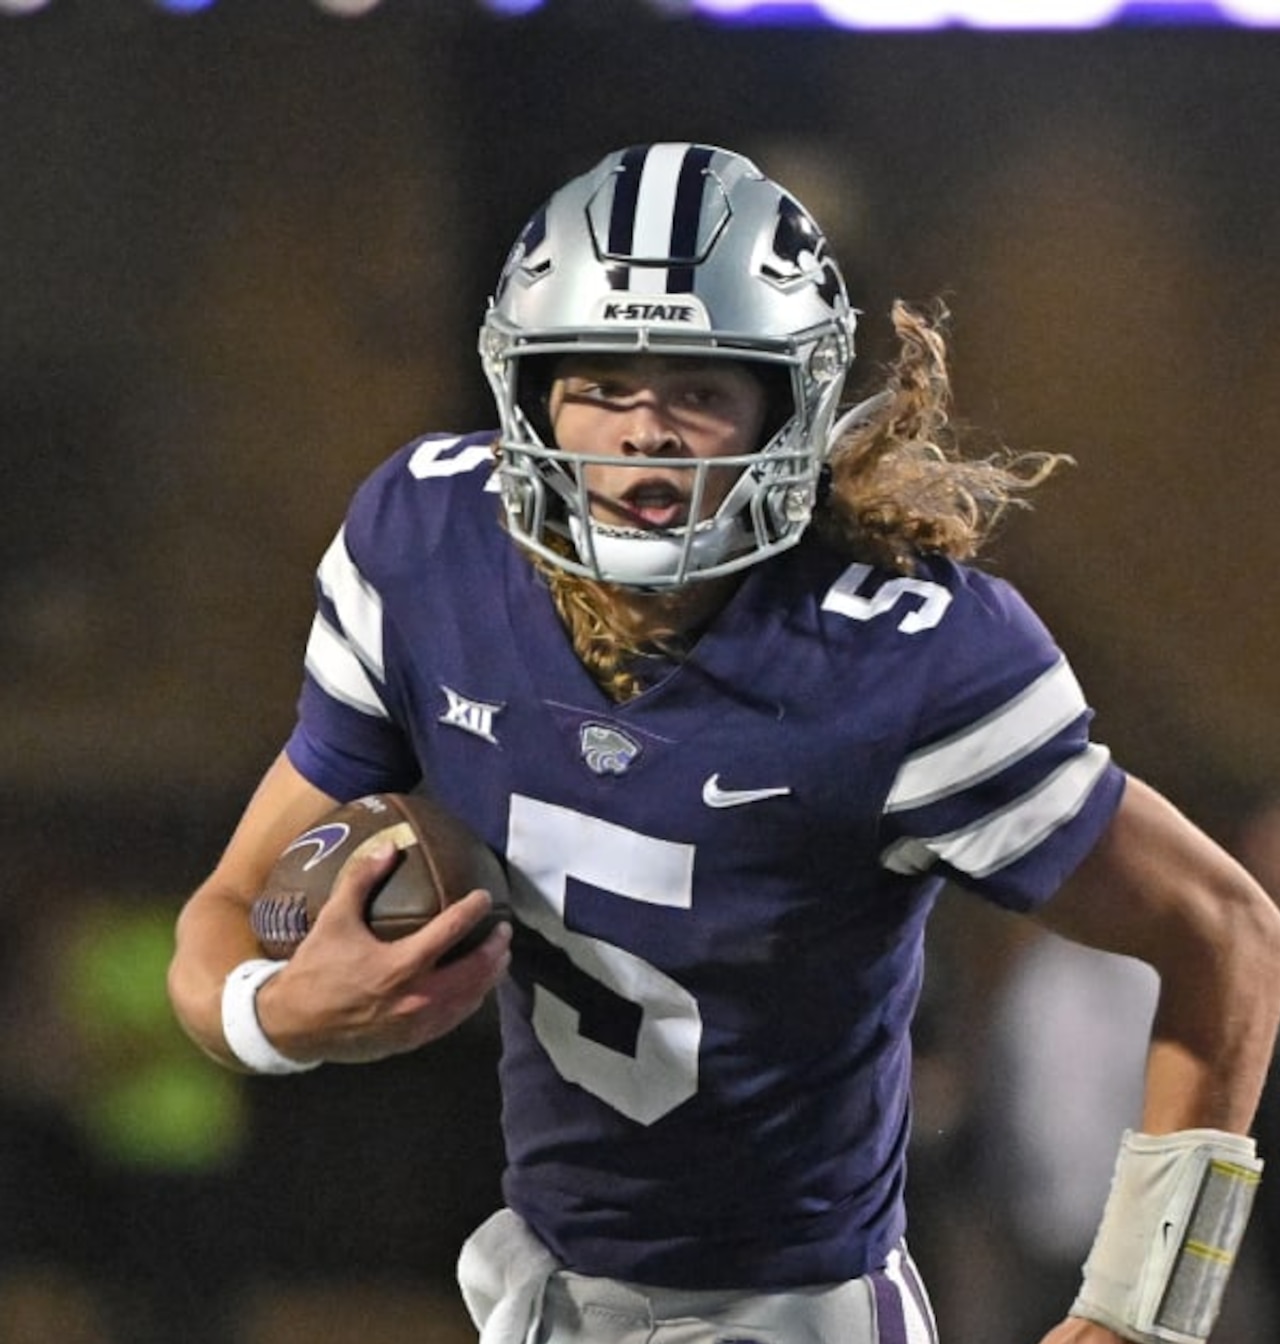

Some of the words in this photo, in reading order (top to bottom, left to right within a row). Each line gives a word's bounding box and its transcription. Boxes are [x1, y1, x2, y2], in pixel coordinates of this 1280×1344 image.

[604, 303, 695, 322] K-STATE
[821, 562, 953, 634] 5
[439, 685, 501, 745] XII
[506, 792, 703, 1127] 5
